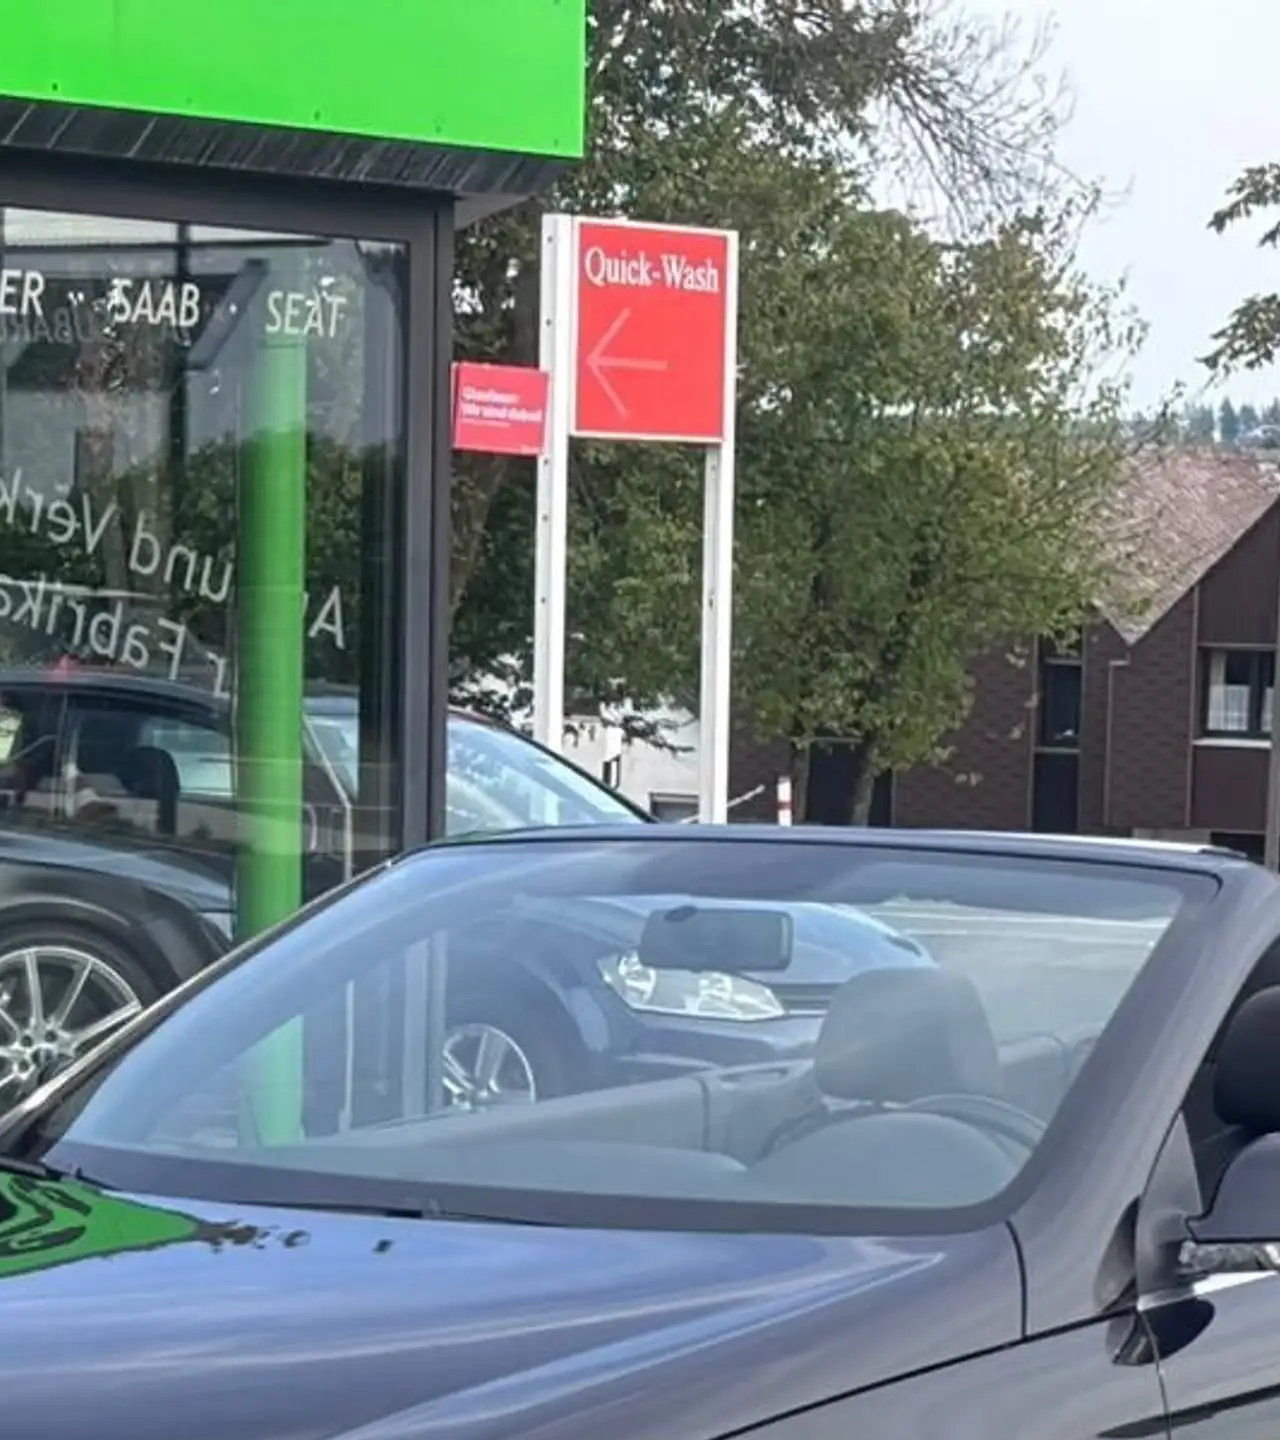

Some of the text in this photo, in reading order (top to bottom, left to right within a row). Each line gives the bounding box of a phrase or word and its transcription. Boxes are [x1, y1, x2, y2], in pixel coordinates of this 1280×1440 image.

[583, 246, 721, 293] Quick-Wash
[112, 279, 201, 328] SAAB
[264, 290, 348, 338] SEAT
